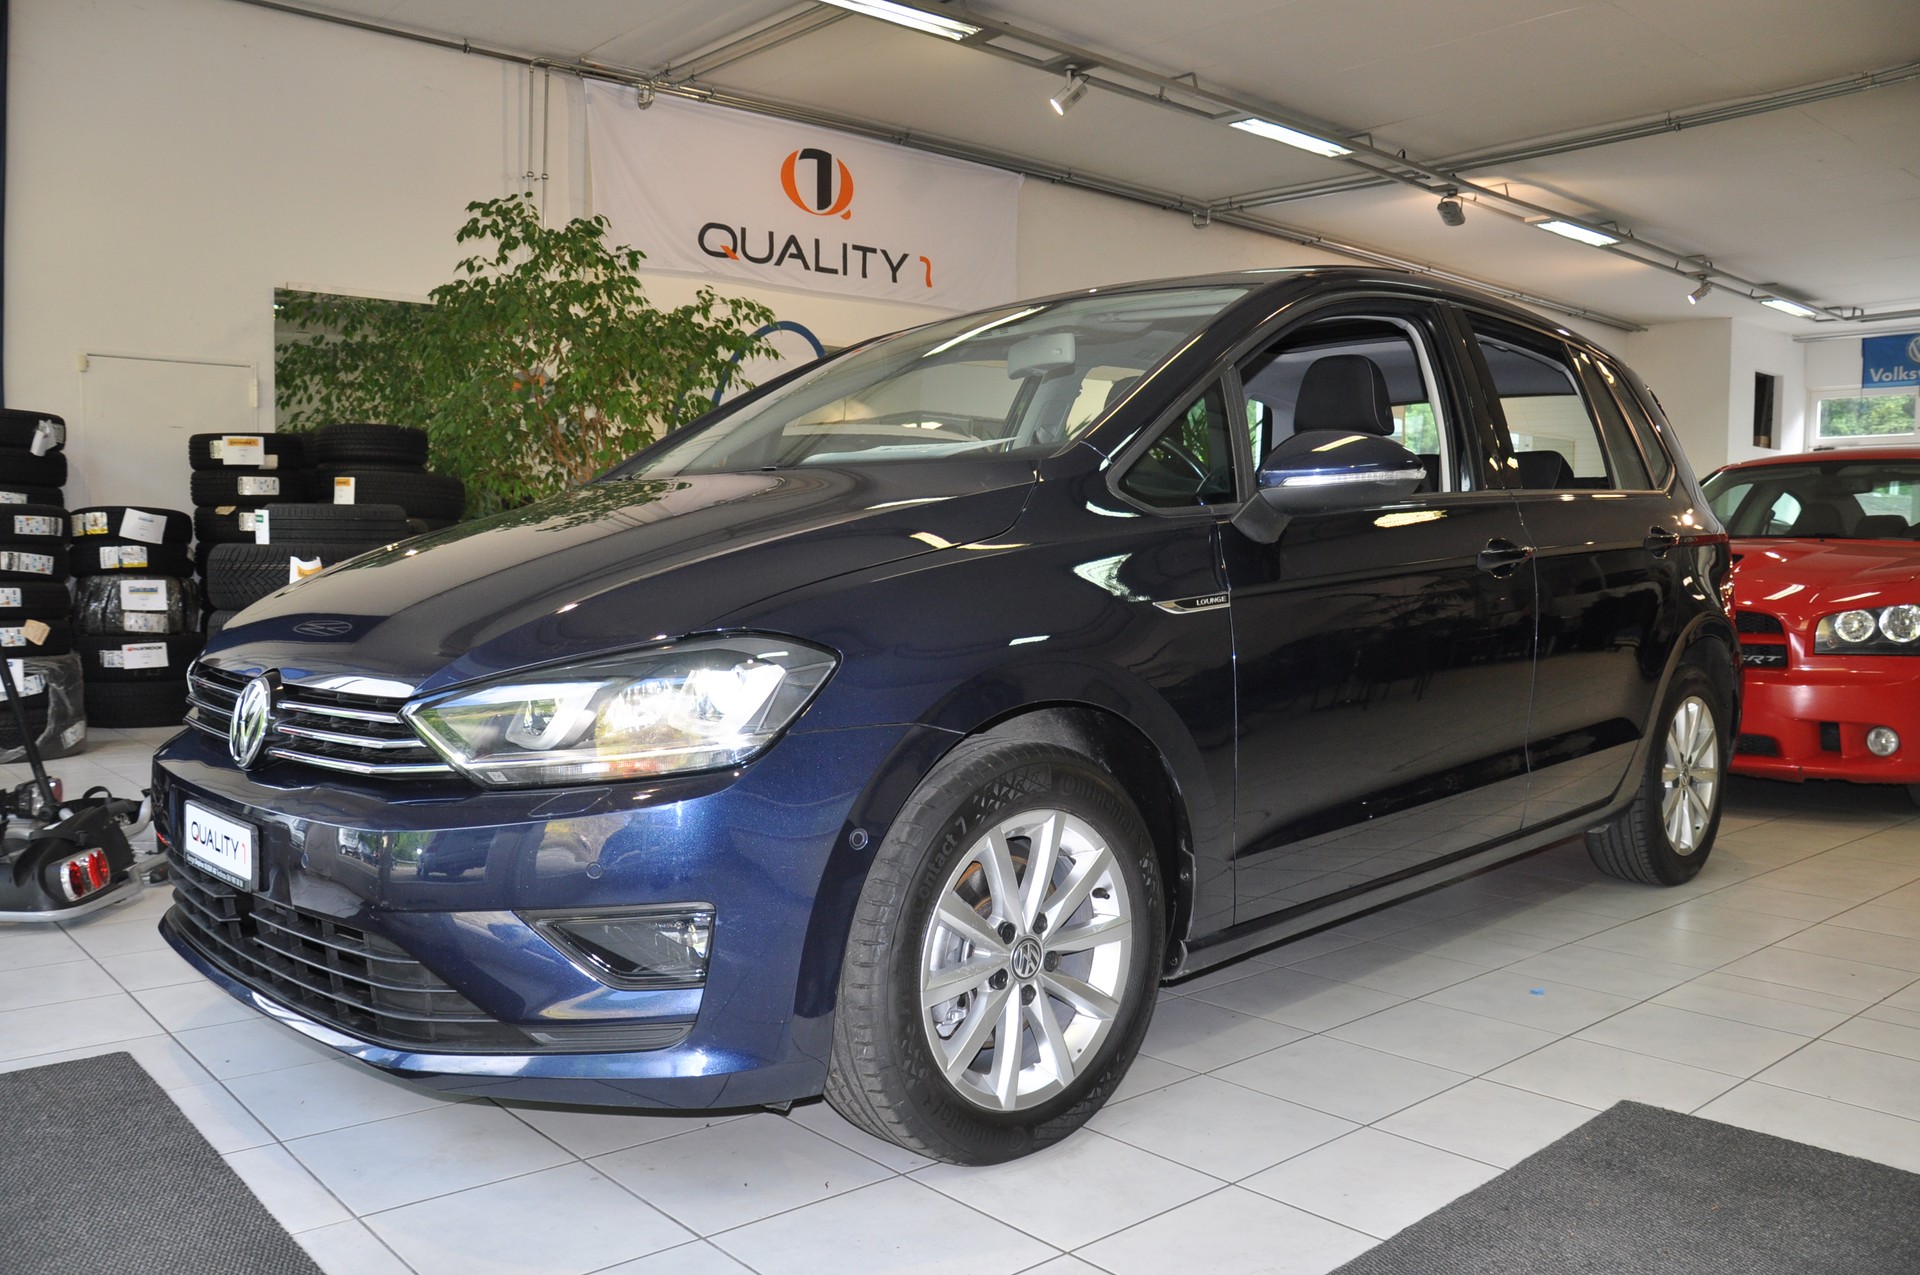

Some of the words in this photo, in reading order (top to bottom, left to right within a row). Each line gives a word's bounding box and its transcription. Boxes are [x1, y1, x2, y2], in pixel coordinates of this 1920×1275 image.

[697, 222, 909, 283] QUALITY
[919, 255, 933, 288] 1
[1869, 366, 1920, 382] Volks
[1196, 595, 1227, 606] LOUNGE
[191, 820, 239, 860] QUALITY
[241, 842, 246, 864] 1
